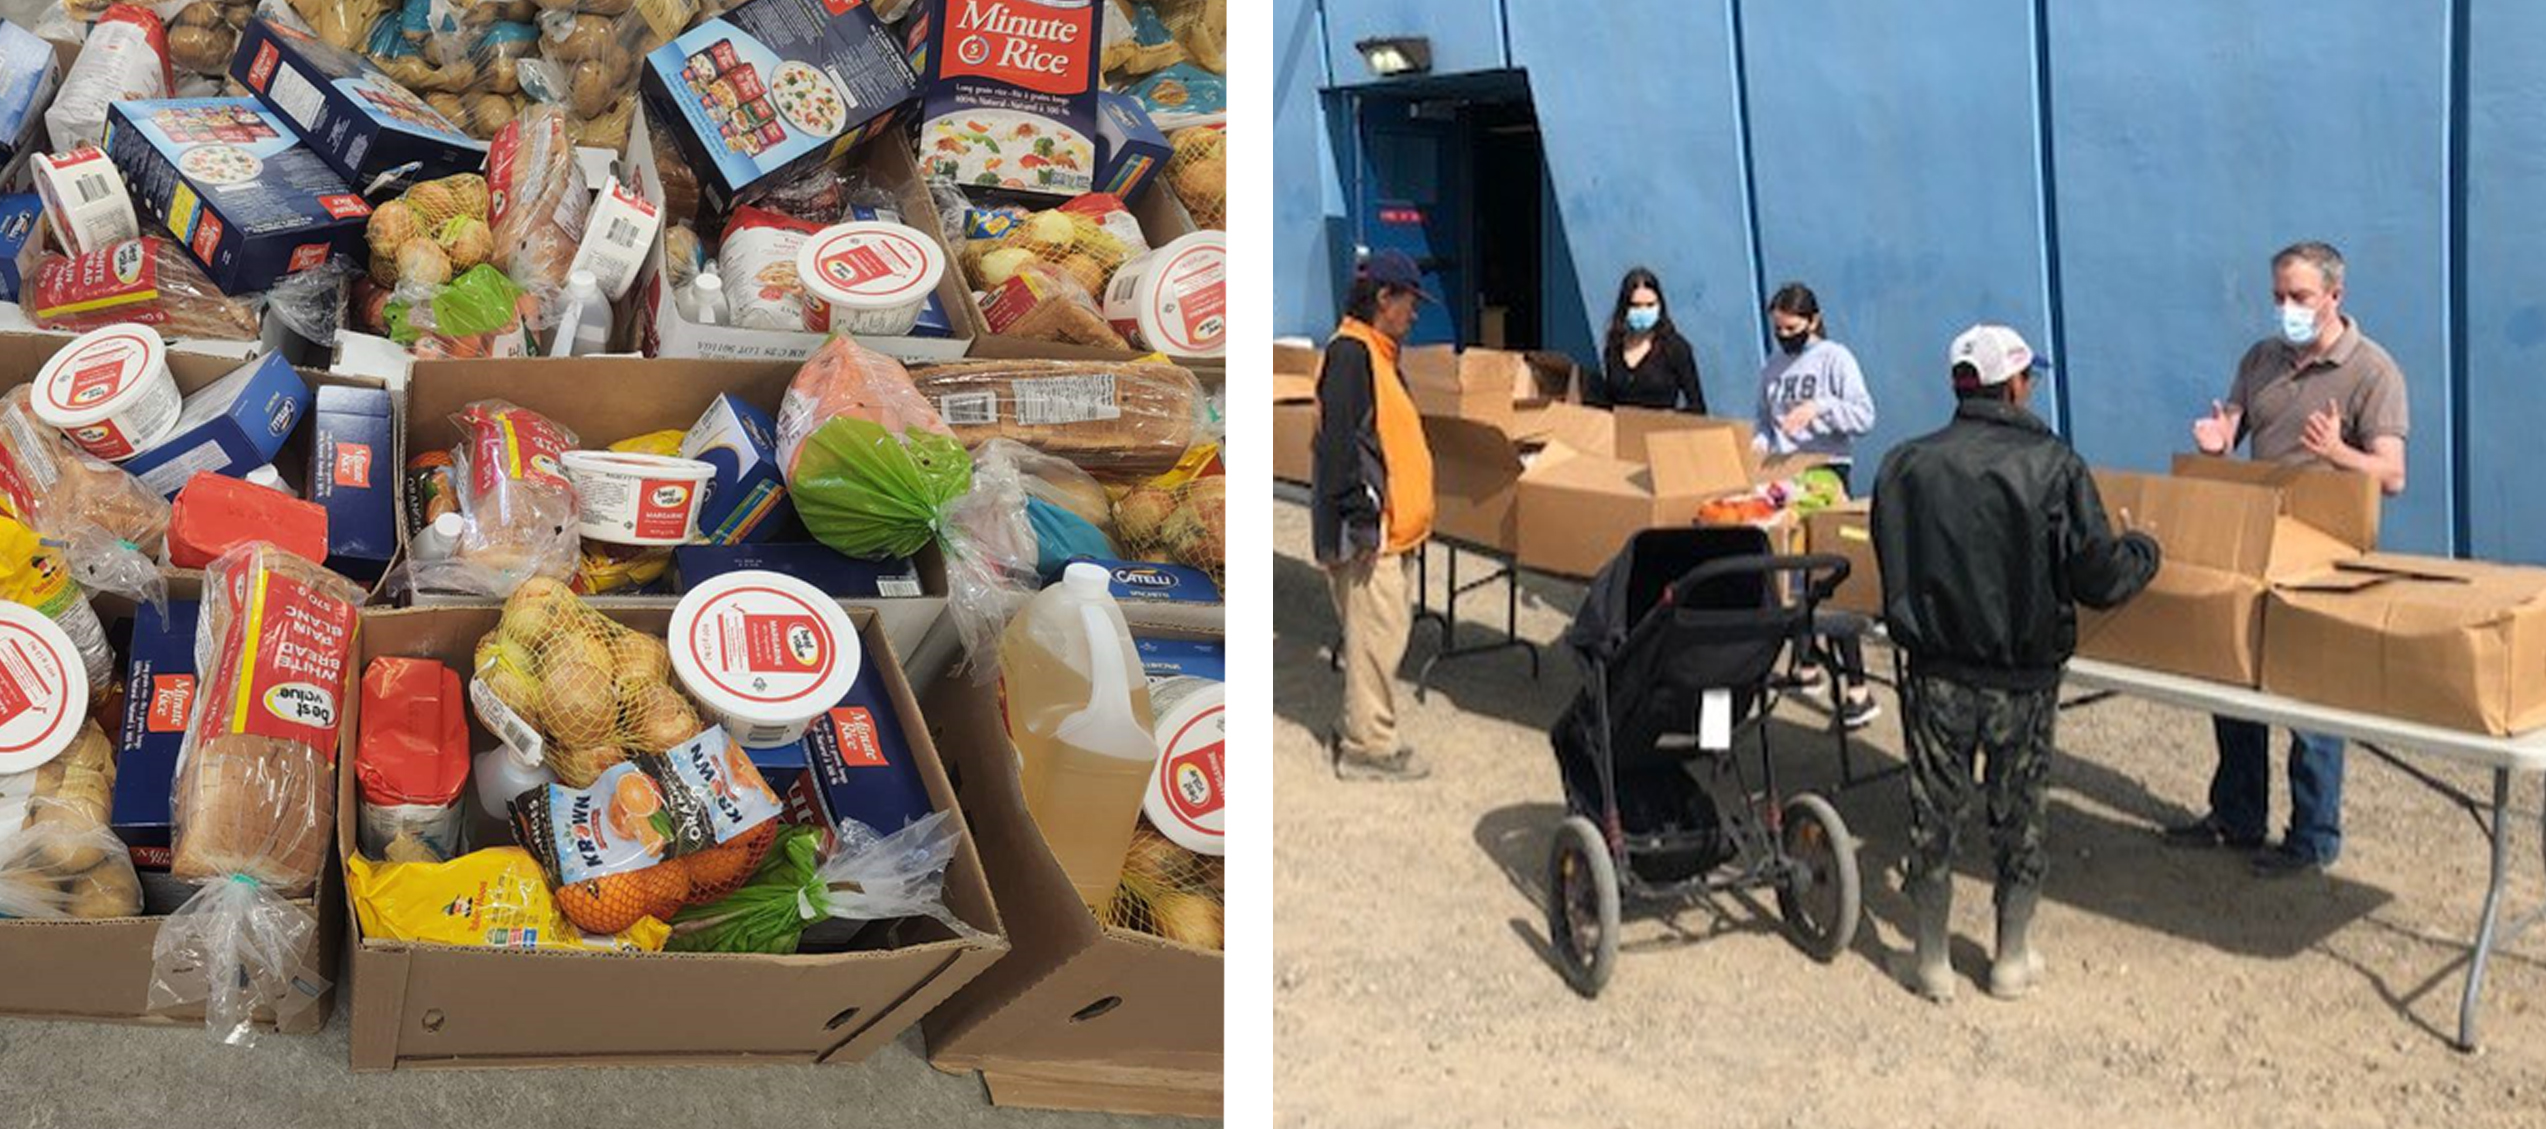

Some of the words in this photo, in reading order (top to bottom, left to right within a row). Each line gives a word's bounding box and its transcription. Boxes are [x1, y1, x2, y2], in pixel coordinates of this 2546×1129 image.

[957, 0, 1079, 43] Minute
[997, 37, 1068, 75] Rice
[1116, 570, 1171, 586] CATELLI
[285, 605, 343, 637] BLANC
[293, 622, 334, 647] PAIN
[770, 619, 784, 667] MARGARINE
[793, 634, 805, 660] value
[800, 629, 814, 649] best
[279, 656, 338, 684] WHITE
[282, 643, 341, 670] BREAD
[155, 688, 170, 717] Rice
[169, 678, 188, 727] Minute
[280, 687, 322, 704] value
[298, 702, 330, 726] best
[839, 720, 858, 750] Rice
[851, 711, 877, 761] Minute
[1183, 783, 1199, 803] best
